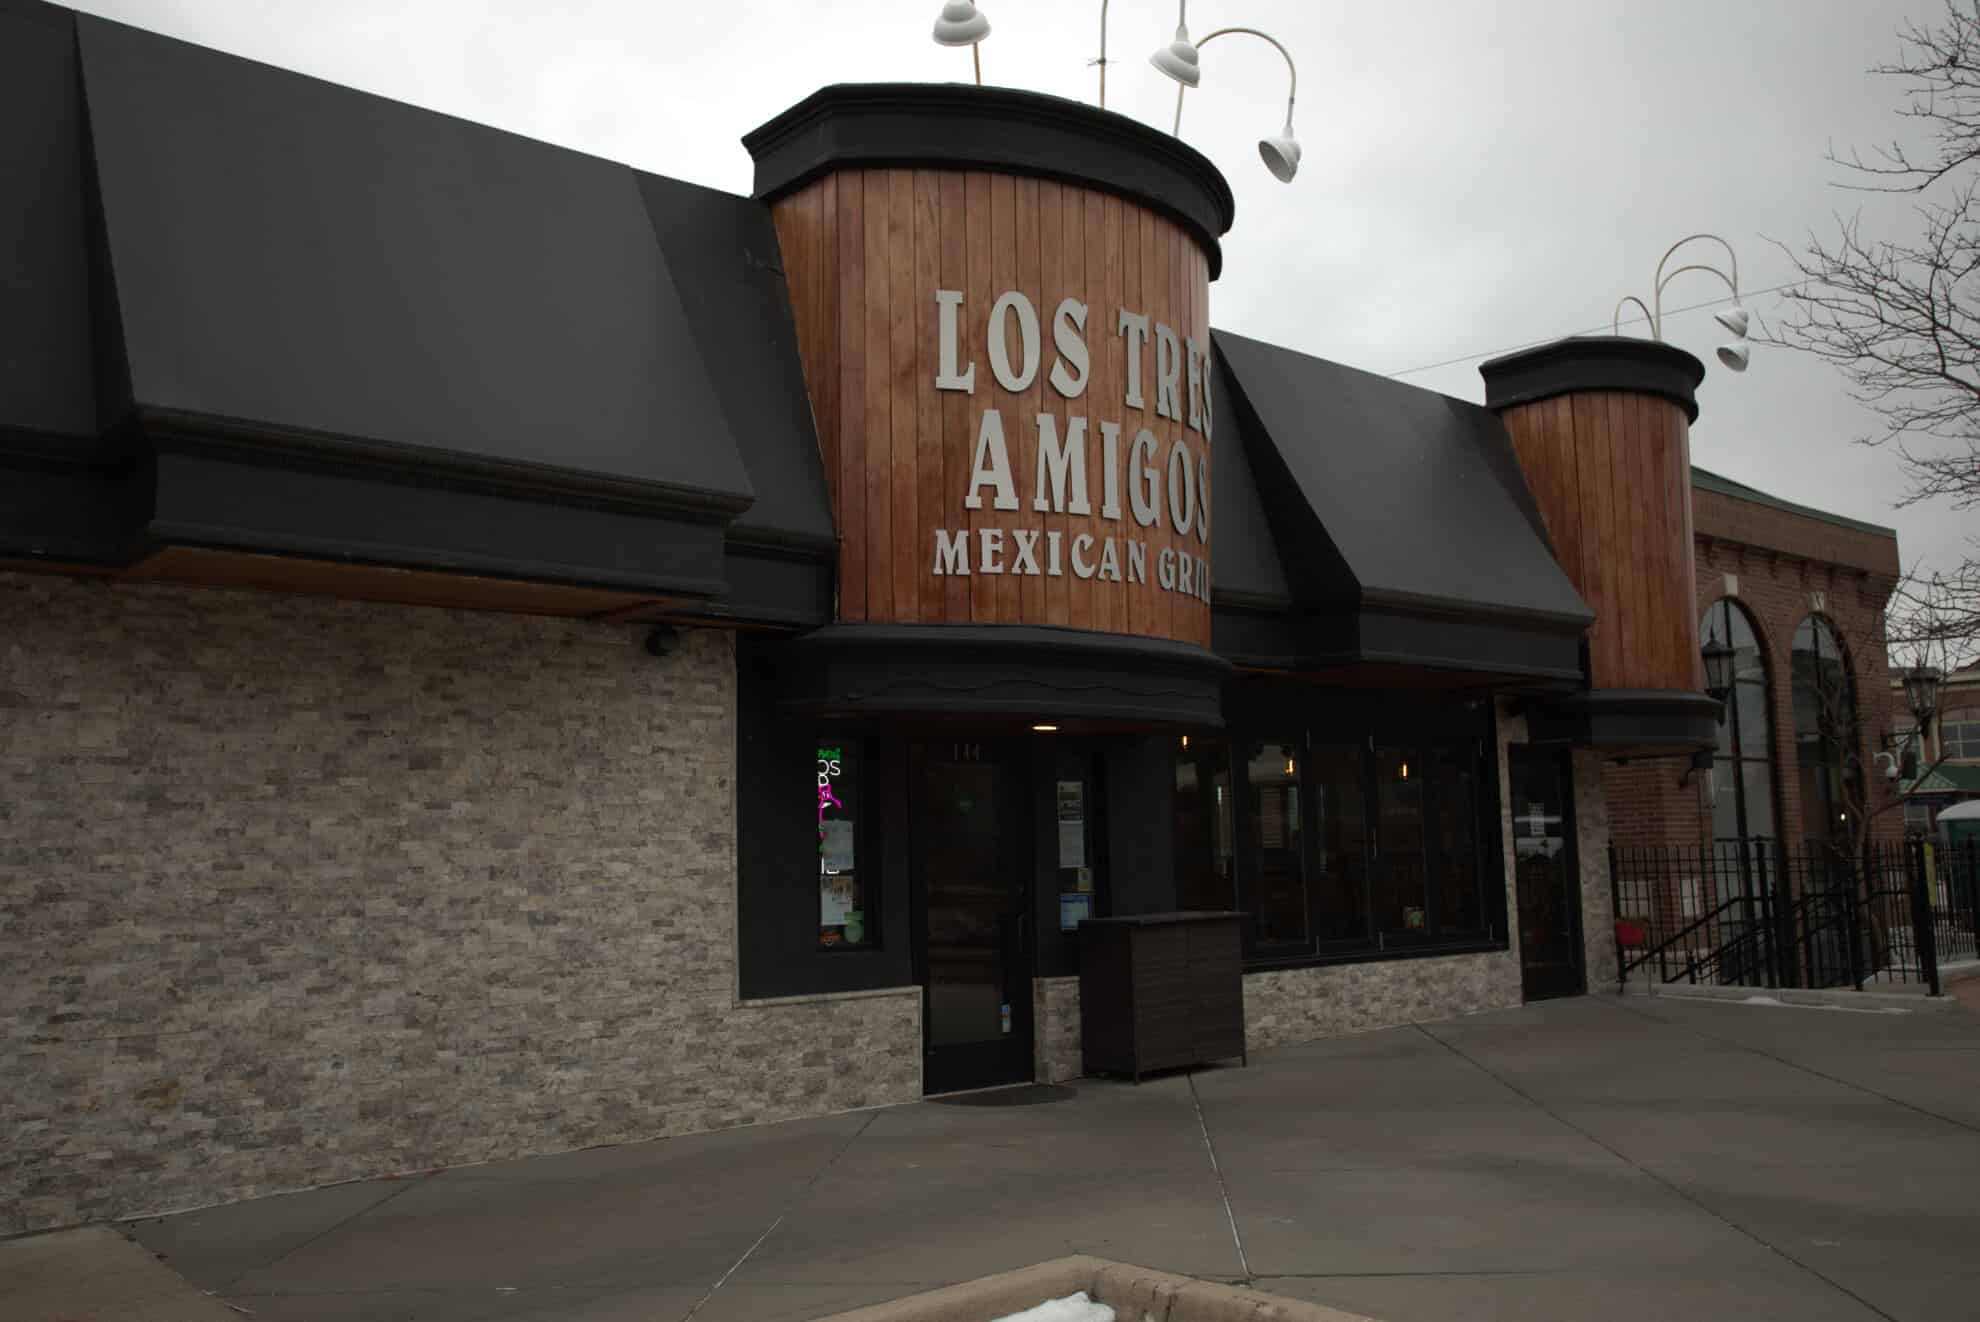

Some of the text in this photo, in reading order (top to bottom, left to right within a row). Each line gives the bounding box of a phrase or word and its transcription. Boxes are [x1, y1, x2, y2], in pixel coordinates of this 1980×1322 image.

[935, 289, 1213, 442] LOS TRES
[965, 409, 1208, 544] AMIGOS
[932, 528, 1146, 585] MEXICAN
